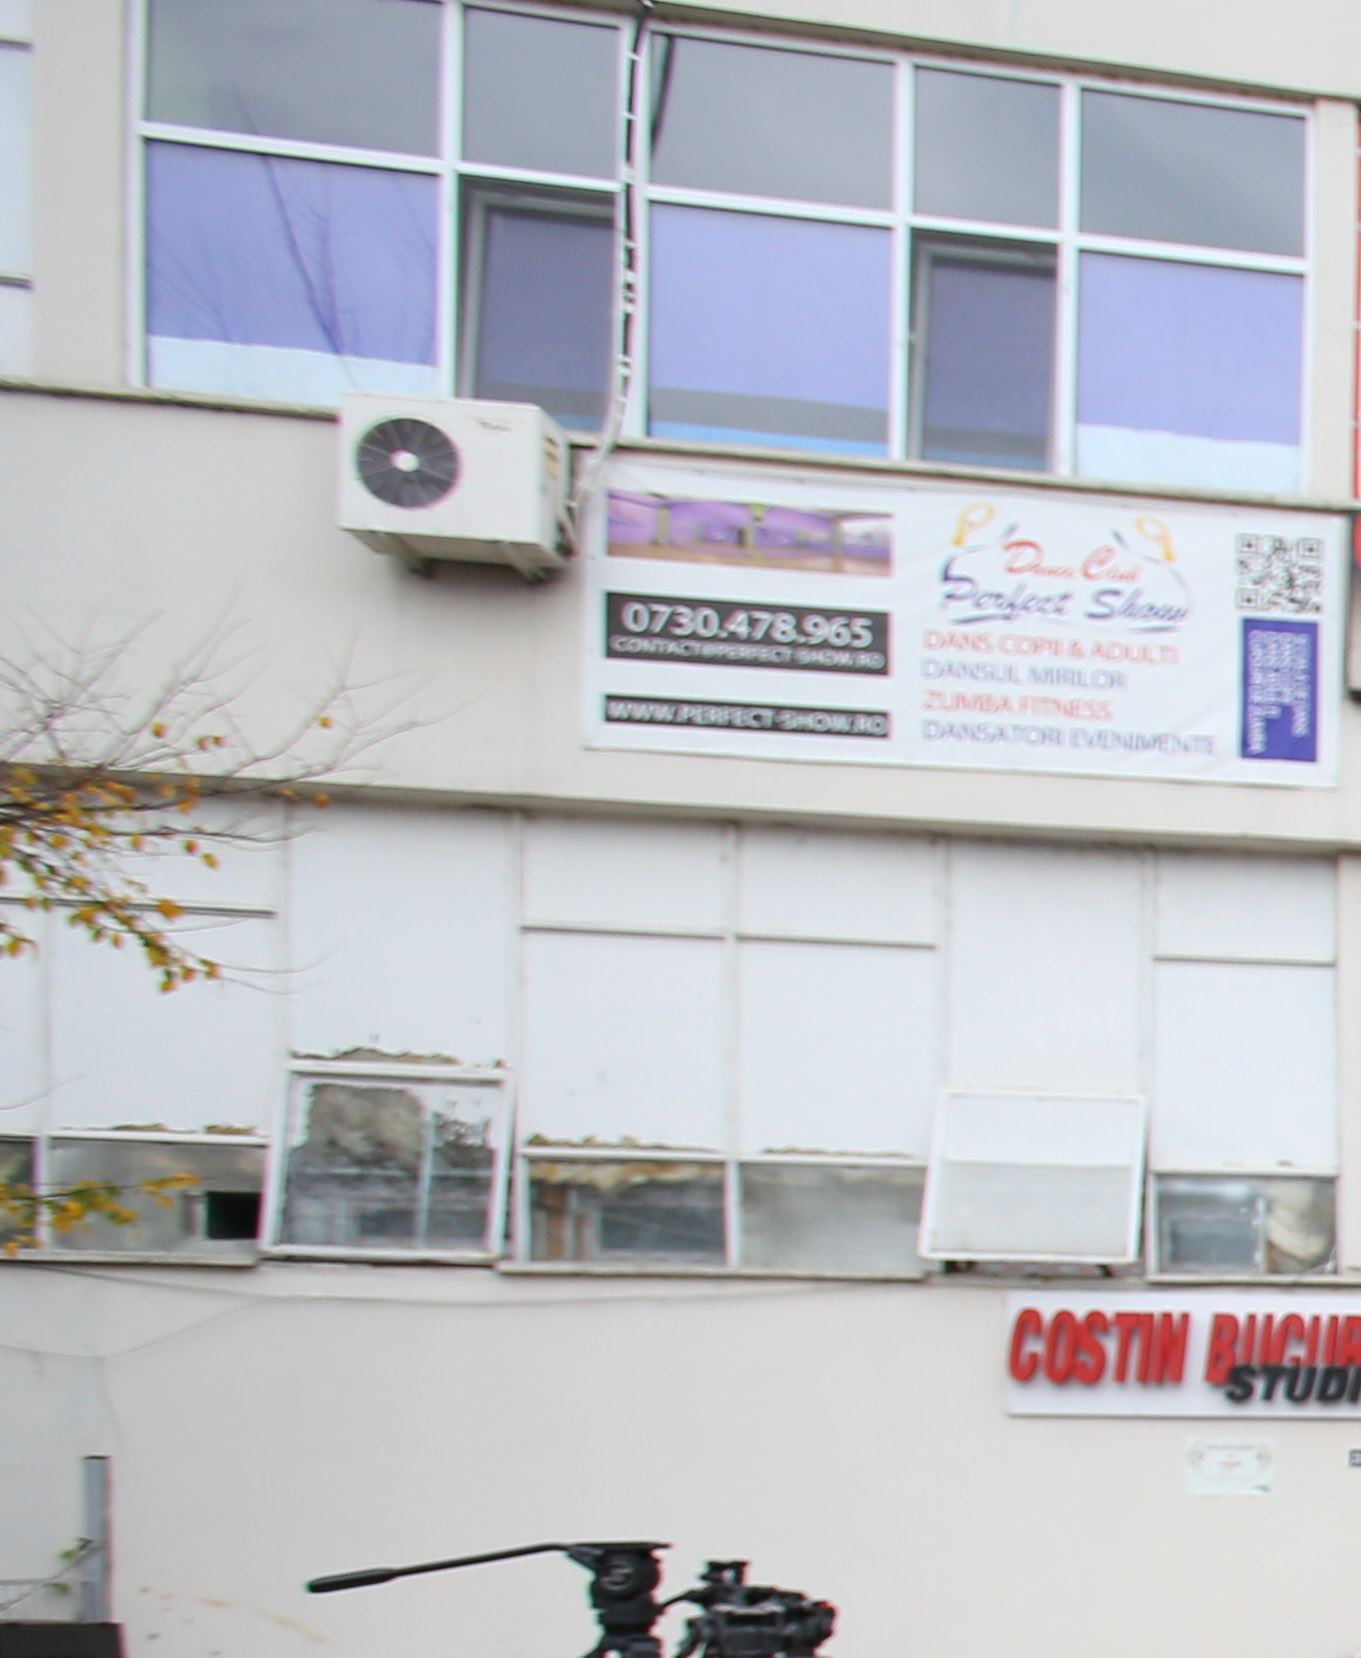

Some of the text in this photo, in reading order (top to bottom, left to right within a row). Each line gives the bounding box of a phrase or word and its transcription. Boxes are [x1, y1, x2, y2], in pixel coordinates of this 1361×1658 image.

[621, 601, 874, 648] 0730.478.965
[923, 628, 994, 653] DANS
[1066, 639, 1085, 659] &
[921, 657, 1022, 684] DANSUL
[607, 701, 888, 736] WWW.PERFECT-SHOW.RO
[922, 689, 1114, 721] ZUMBA FITNESS
[1008, 1307, 1190, 1384] COSTIN
